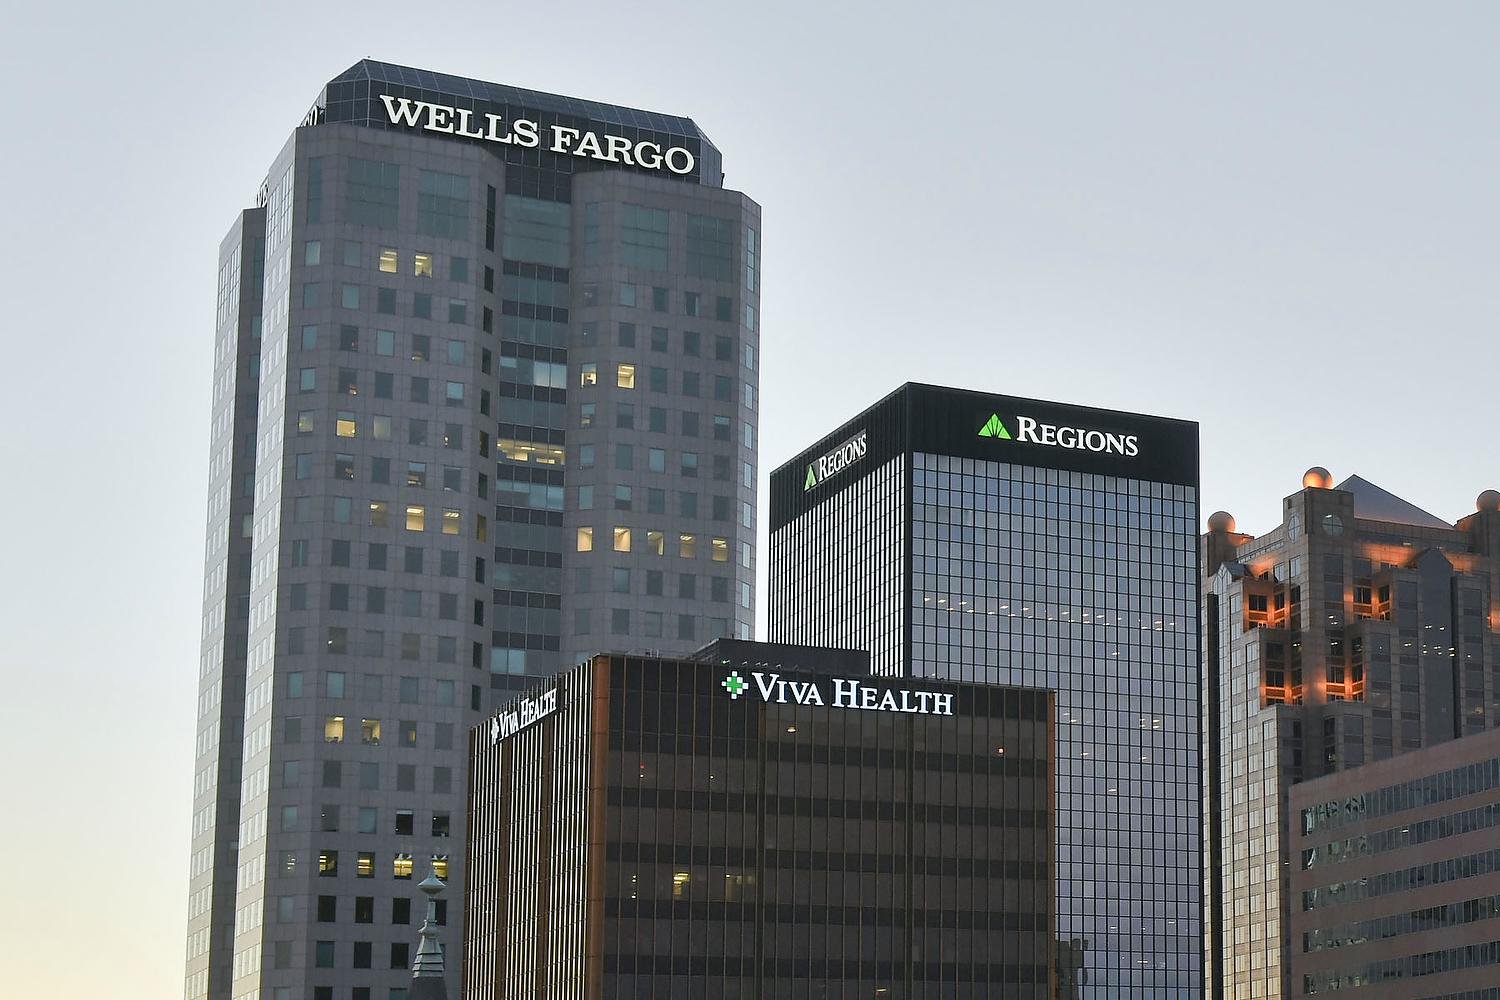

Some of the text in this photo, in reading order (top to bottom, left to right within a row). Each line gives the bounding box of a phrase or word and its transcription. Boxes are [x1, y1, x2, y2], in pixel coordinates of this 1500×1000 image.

[379, 95, 539, 147] WELLS
[550, 125, 695, 175] FARGO
[818, 433, 867, 482] REGIONS
[1016, 415, 1139, 457] REGIONS
[499, 687, 557, 741] VIVA HEALTH
[752, 672, 954, 716] VIVA HEALTH
